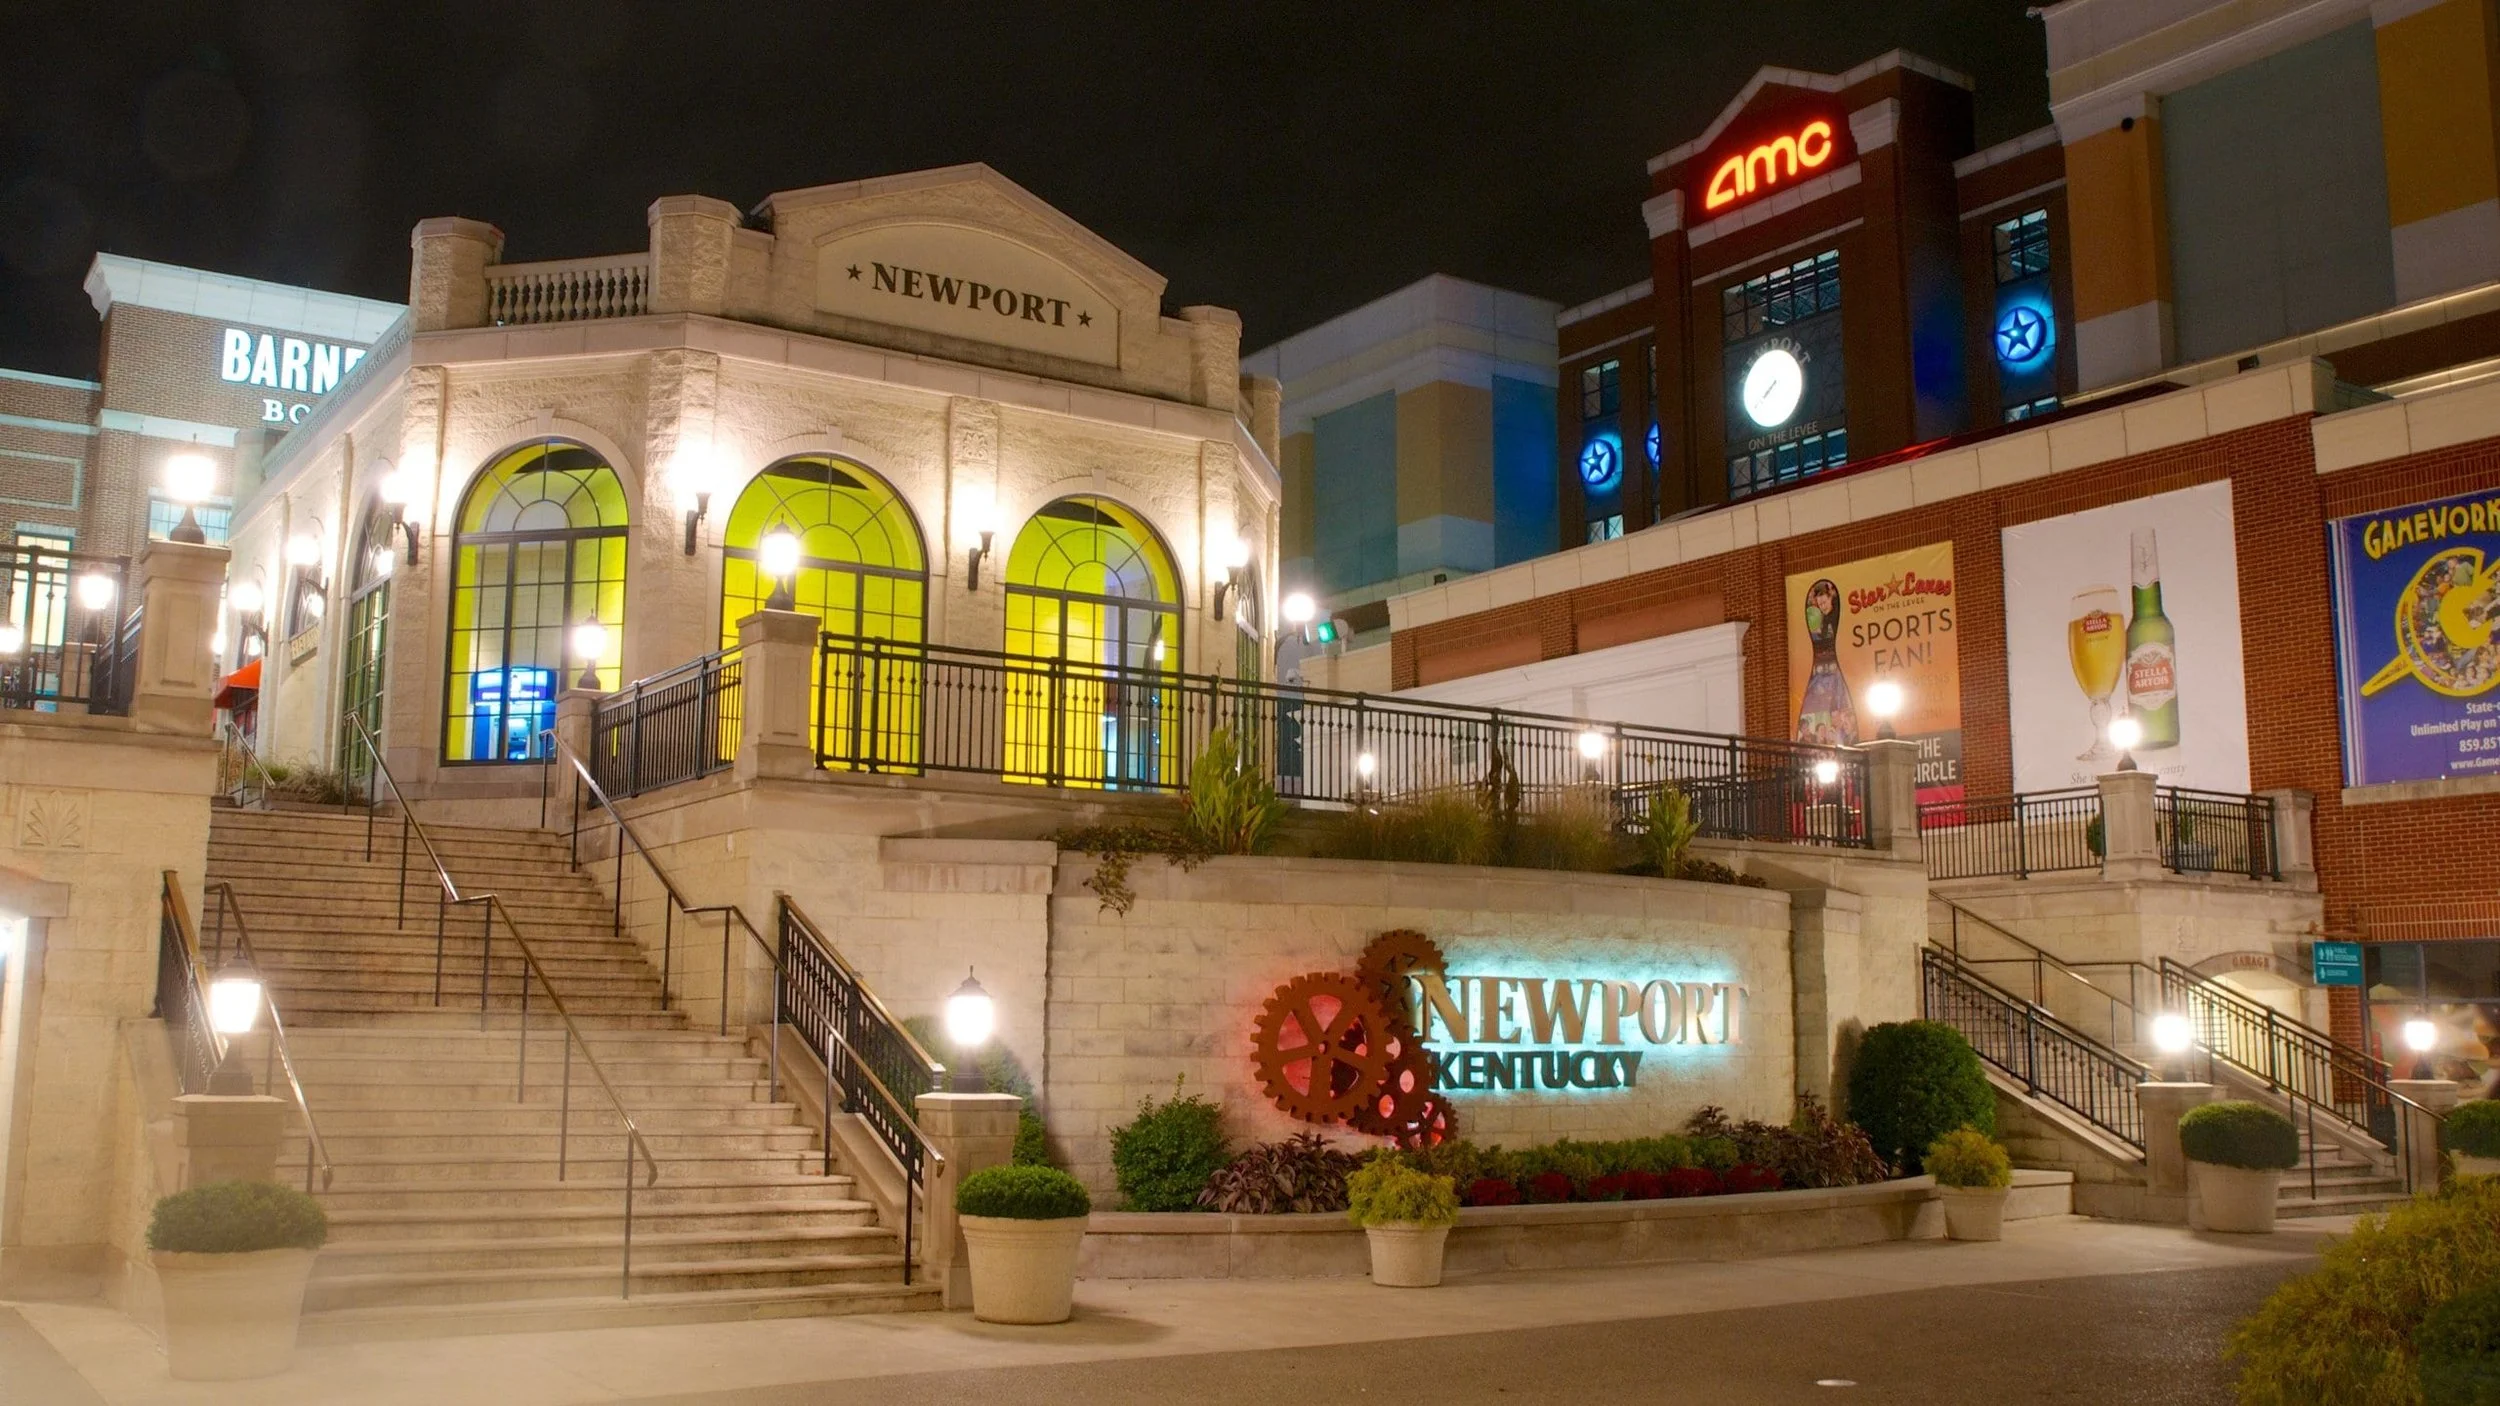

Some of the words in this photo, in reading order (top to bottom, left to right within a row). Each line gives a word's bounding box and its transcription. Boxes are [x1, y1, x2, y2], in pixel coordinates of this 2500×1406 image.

[871, 261, 1071, 327] NEWPORT
[1748, 437, 1765, 451] ON
[1768, 432, 1786, 444] THE
[1789, 421, 1818, 439] LEVEE
[2364, 498, 2500, 560] GAMEWORK
[1848, 586, 1887, 614] Star
[1901, 571, 1952, 596] Lanes
[1873, 605, 1885, 613] ON
[1887, 602, 1900, 610] THE
[1852, 608, 1953, 648] SPORTS
[1874, 641, 1933, 673] FAN!
[2134, 667, 2168, 679] STELLA
[2135, 675, 2170, 688] ARTOIS
[2411, 720, 2459, 736] Unlimited
[2460, 718, 2481, 732] Play
[2484, 718, 2496, 728] on
[1916, 737, 1941, 759] THE
[1913, 760, 1956, 784] IRCLE
[2070, 772, 2087, 785] She
[1404, 972, 1750, 1047] NEWPORT
[1430, 1050, 1644, 1090] KENTUCKY
